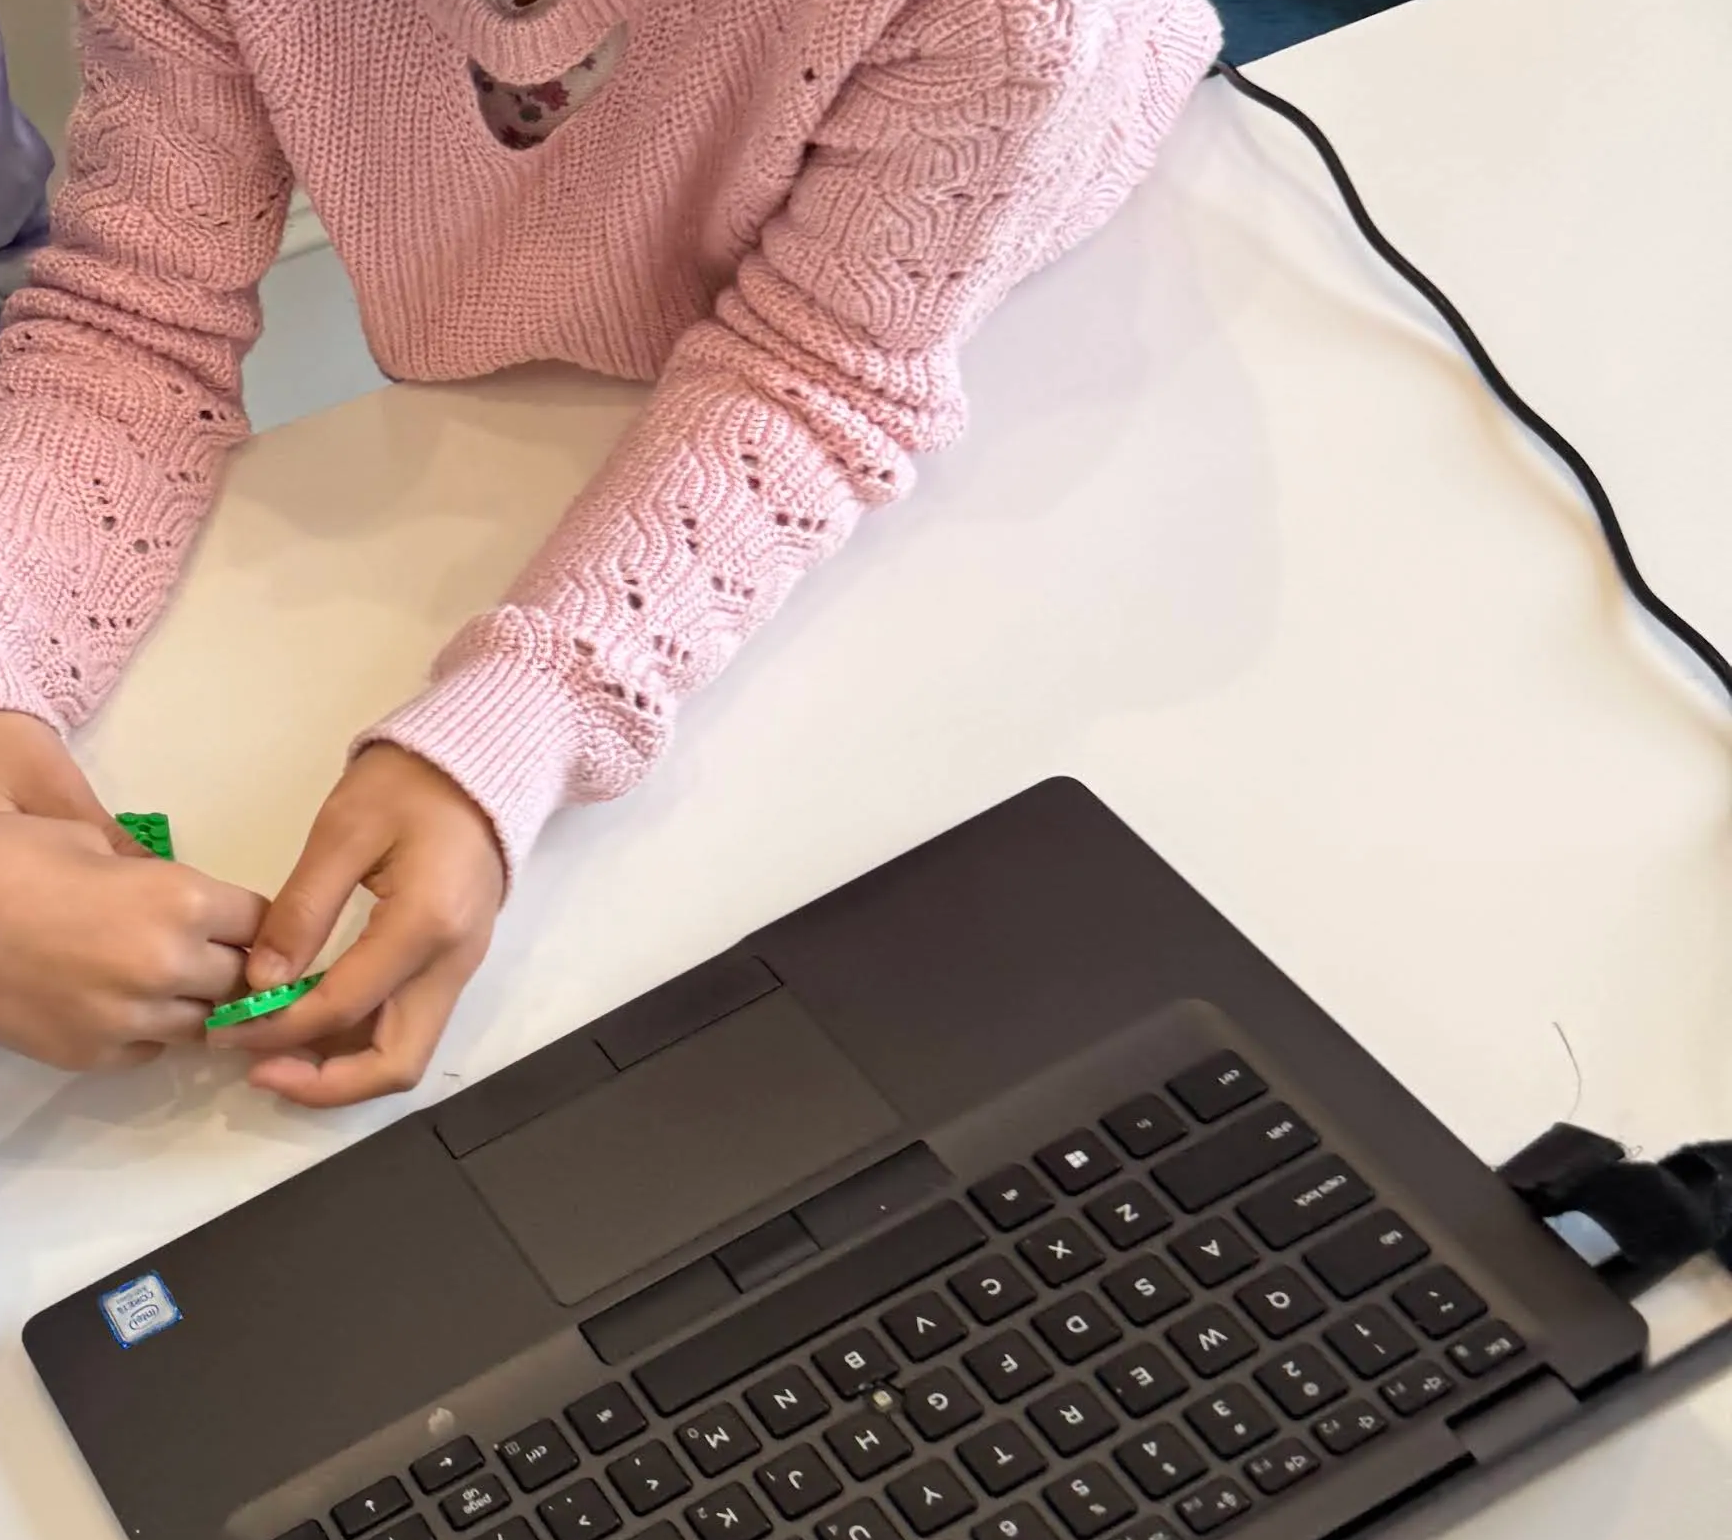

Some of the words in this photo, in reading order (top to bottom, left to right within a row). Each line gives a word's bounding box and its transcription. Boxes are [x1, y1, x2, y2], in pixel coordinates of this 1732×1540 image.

[1217, 1068, 1240, 1085] ctrl
[1265, 1120, 1293, 1139] shift
[1000, 1188, 1018, 1201] alt
[1317, 1174, 1347, 1198] caps
[1293, 1188, 1322, 1206] lock
[1114, 1202, 1139, 1222] Z
[1047, 1239, 1072, 1259] X
[1199, 1238, 1221, 1257] A
[979, 1277, 1002, 1295] C
[1133, 1276, 1156, 1296] S
[1264, 1290, 1291, 1309] Q
[915, 1315, 936, 1334] V
[1065, 1314, 1089, 1333] D
[1354, 1322, 1370, 1337] 1
[1197, 1327, 1228, 1351] W
[1484, 1336, 1512, 1355] Esc
[843, 1350, 866, 1369] B
[1000, 1352, 1018, 1373] F
[1281, 1359, 1301, 1378] 2
[1129, 1365, 1154, 1386] E
[772, 1387, 798, 1409] N
[926, 1391, 949, 1411] G
[1058, 1404, 1084, 1424] R
[1211, 1399, 1231, 1417] 3
[703, 1425, 730, 1449] M
[853, 1428, 880, 1450] H
[524, 1444, 547, 1463] ctrl
[992, 1445, 1013, 1465] T
[1141, 1440, 1157, 1457] 4
[787, 1469, 803, 1489] J
[1070, 1478, 1090, 1496] 5
[461, 1487, 480, 1501] up
[462, 1492, 492, 1514] page
[922, 1485, 943, 1505] Y
[715, 1506, 739, 1528] K
[998, 1519, 1018, 1537] 6
